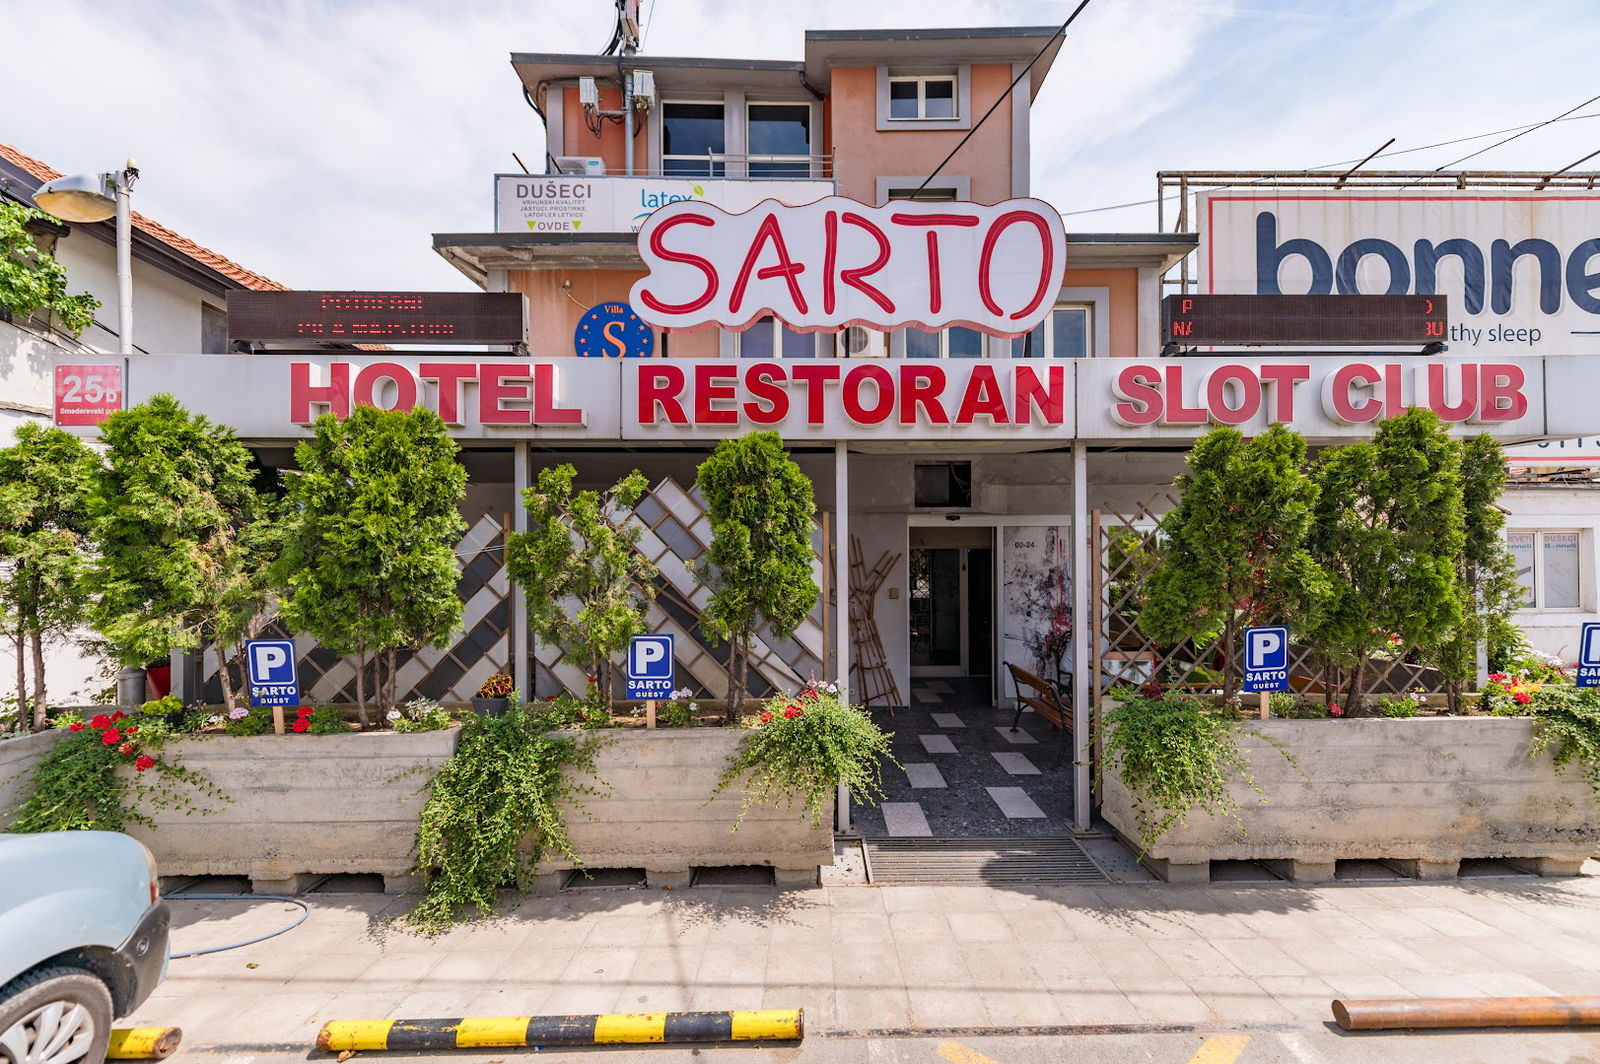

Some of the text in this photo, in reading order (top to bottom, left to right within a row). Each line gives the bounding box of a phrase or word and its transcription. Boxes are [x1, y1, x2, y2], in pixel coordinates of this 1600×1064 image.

[516, 180, 591, 199] DUŠECI
[538, 222, 569, 231] OVDE
[640, 211, 1053, 320] SARTO
[604, 305, 624, 314] Villa
[602, 320, 627, 360] S
[1488, 323, 1541, 346] sleep
[62, 374, 117, 403] 25b
[290, 362, 588, 427] HOTEL
[637, 363, 1066, 427] RESTORAN
[1110, 362, 1529, 427] SLOT CLUB
[628, 680, 671, 690] SARTO
[1246, 670, 1286, 682] SARTO
[251, 686, 296, 697] SARTO
